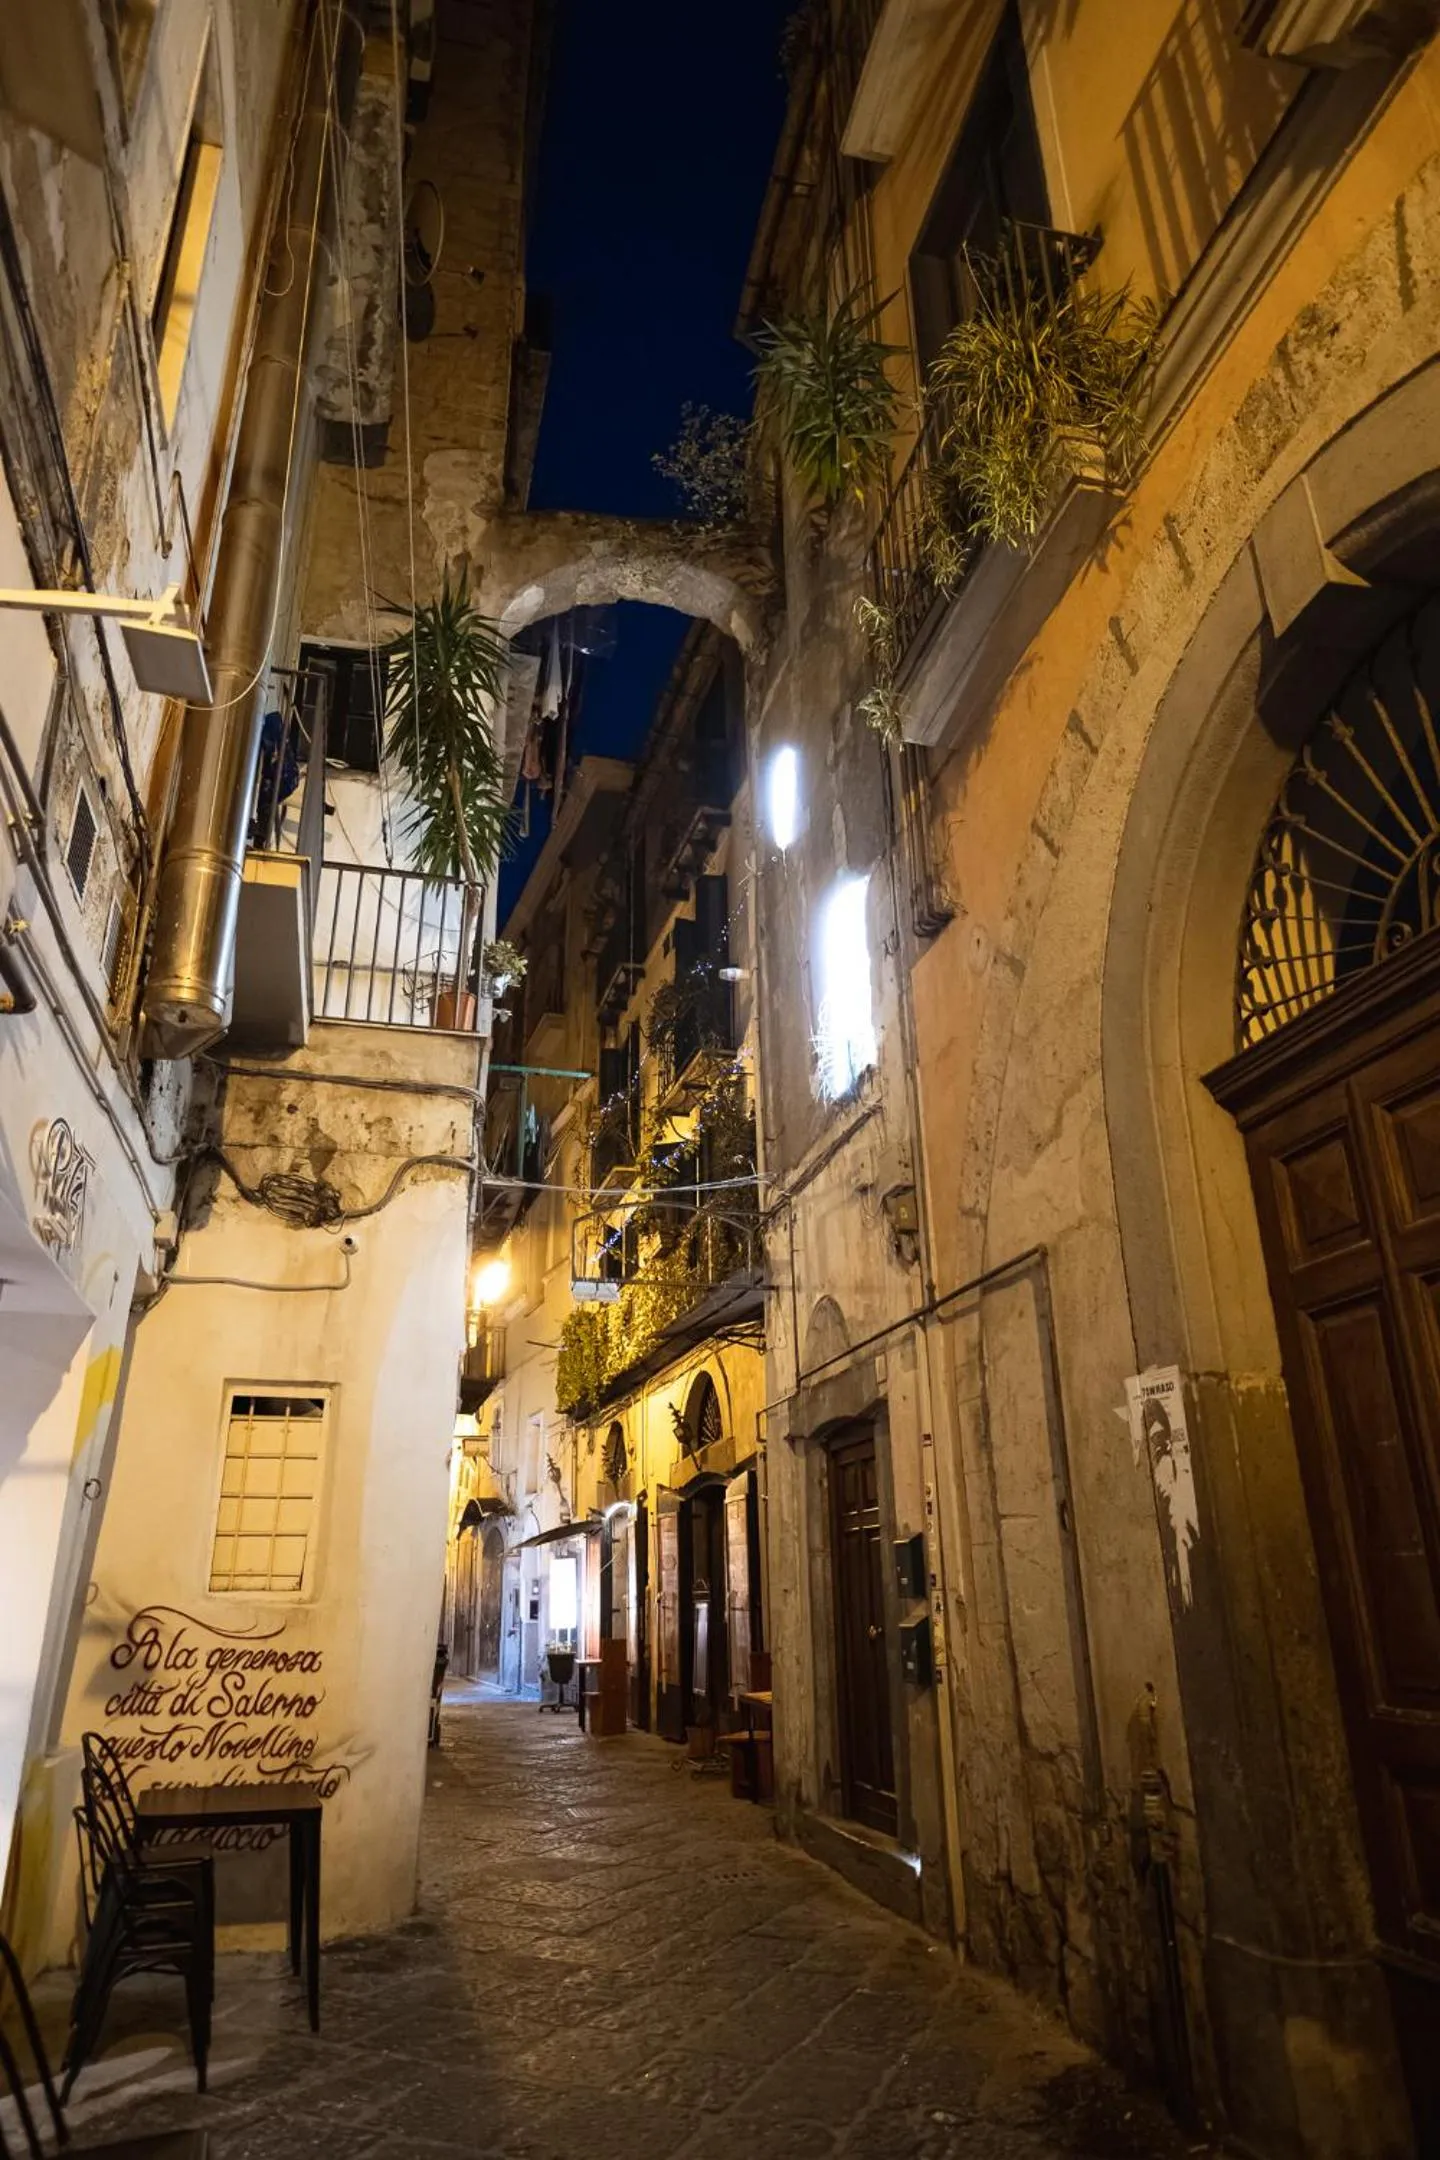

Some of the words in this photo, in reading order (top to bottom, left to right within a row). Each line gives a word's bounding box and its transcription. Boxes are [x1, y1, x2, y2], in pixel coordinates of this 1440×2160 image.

[196, 1647, 323, 1689] generosa
[168, 1671, 208, 1717] di
[207, 1671, 326, 1718] Salerno
[98, 1723, 205, 1766] questo
[191, 1720, 320, 1760] Novellino
